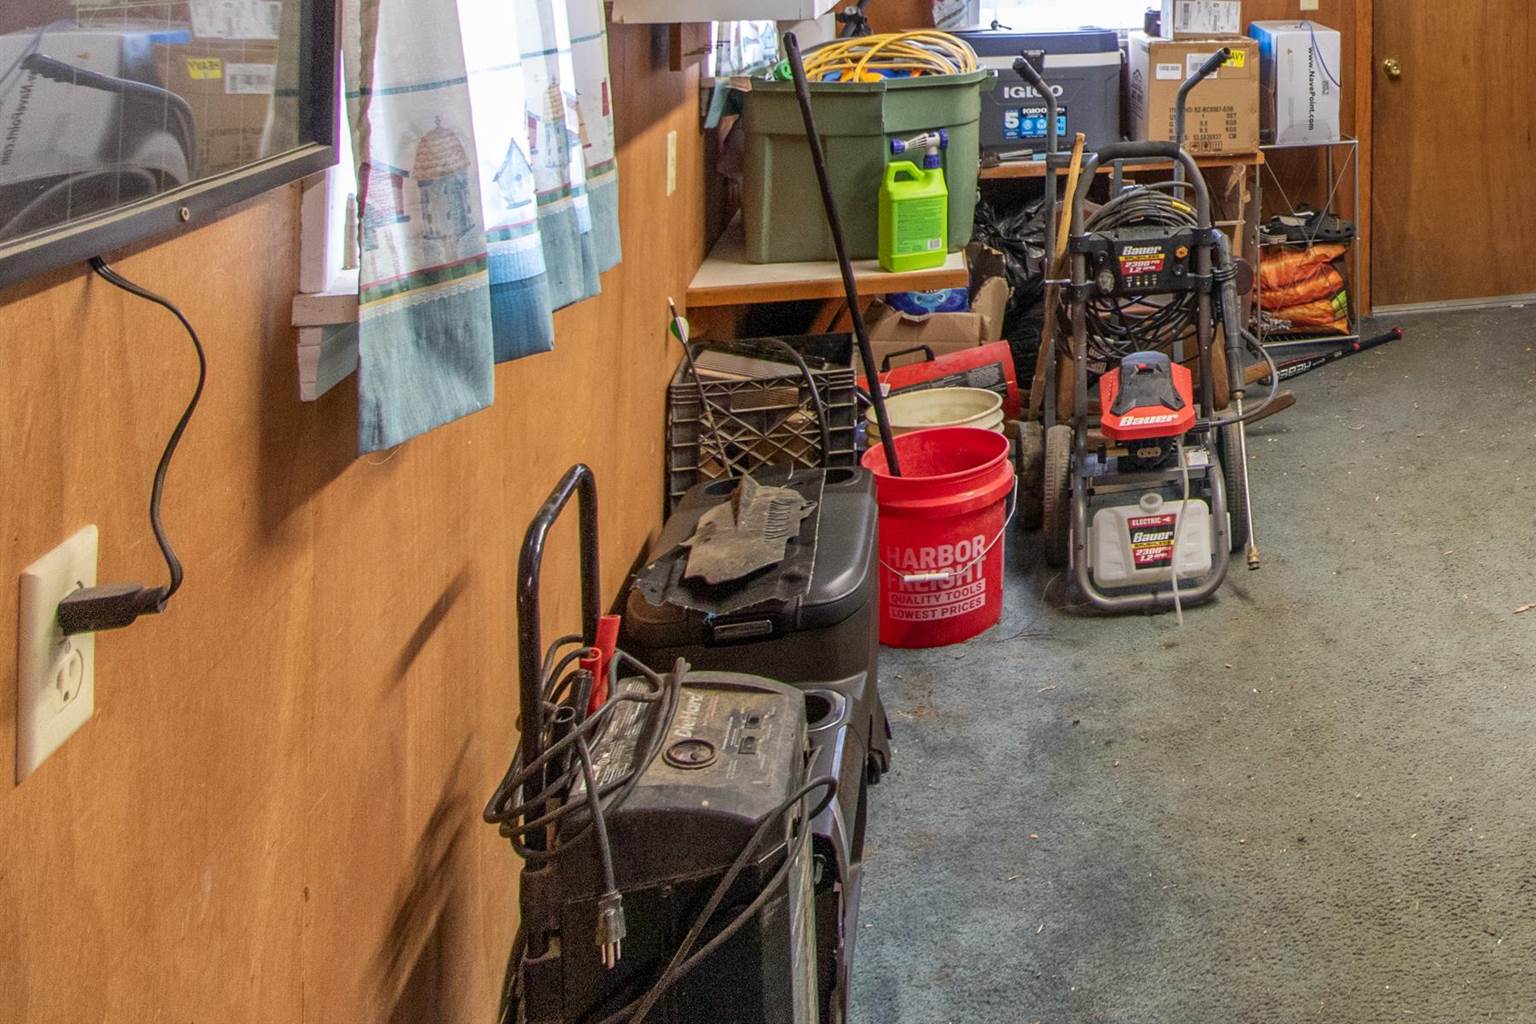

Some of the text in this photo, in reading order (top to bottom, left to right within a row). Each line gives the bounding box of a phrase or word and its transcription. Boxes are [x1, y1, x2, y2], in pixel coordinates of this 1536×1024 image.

[1308, 46, 1316, 131] www.NavePoint.com
[1004, 111, 1020, 129] 5
[1122, 245, 1162, 256] Bauer
[1119, 414, 1179, 426] Bauer
[1133, 531, 1174, 543] Bauer
[886, 534, 986, 569] HARBOR
[890, 581, 983, 605] QUALITY TOOLS
[890, 596, 982, 620] LOWEST PRICES
[673, 691, 704, 739] DieHard
